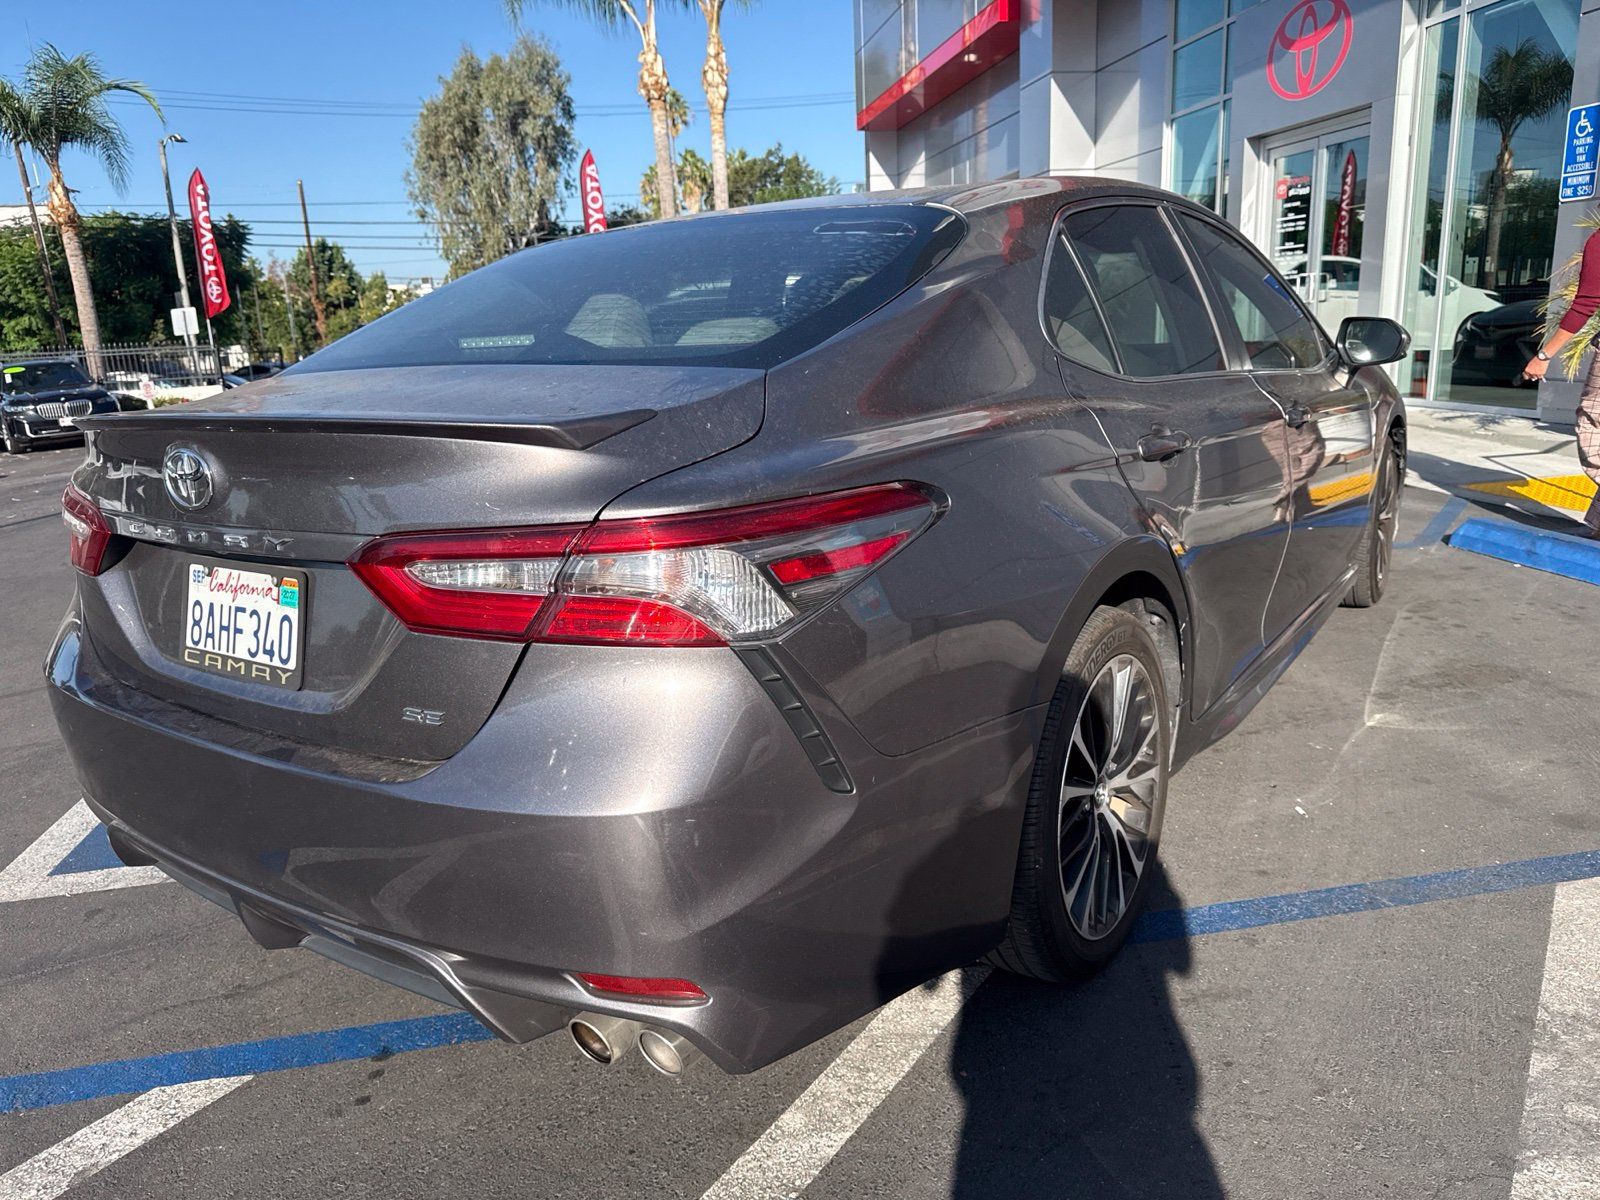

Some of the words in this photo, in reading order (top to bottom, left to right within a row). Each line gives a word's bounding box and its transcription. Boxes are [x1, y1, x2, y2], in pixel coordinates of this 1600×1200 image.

[1573, 136, 1594, 146] PARKING
[1576, 146, 1588, 154] ONLY
[1567, 162, 1594, 172] ACCESSIBLE
[1567, 175, 1590, 186] MINIMUM
[586, 164, 605, 233] OYOTA
[1563, 187, 1574, 197] FINE
[1577, 185, 1592, 195] $250
[128, 522, 294, 551] CAMRY
[192, 570, 205, 584] SEP
[209, 567, 279, 604] California
[190, 599, 293, 666] 8AHF340
[184, 649, 293, 685] CAMRY
[402, 707, 446, 725] SE
